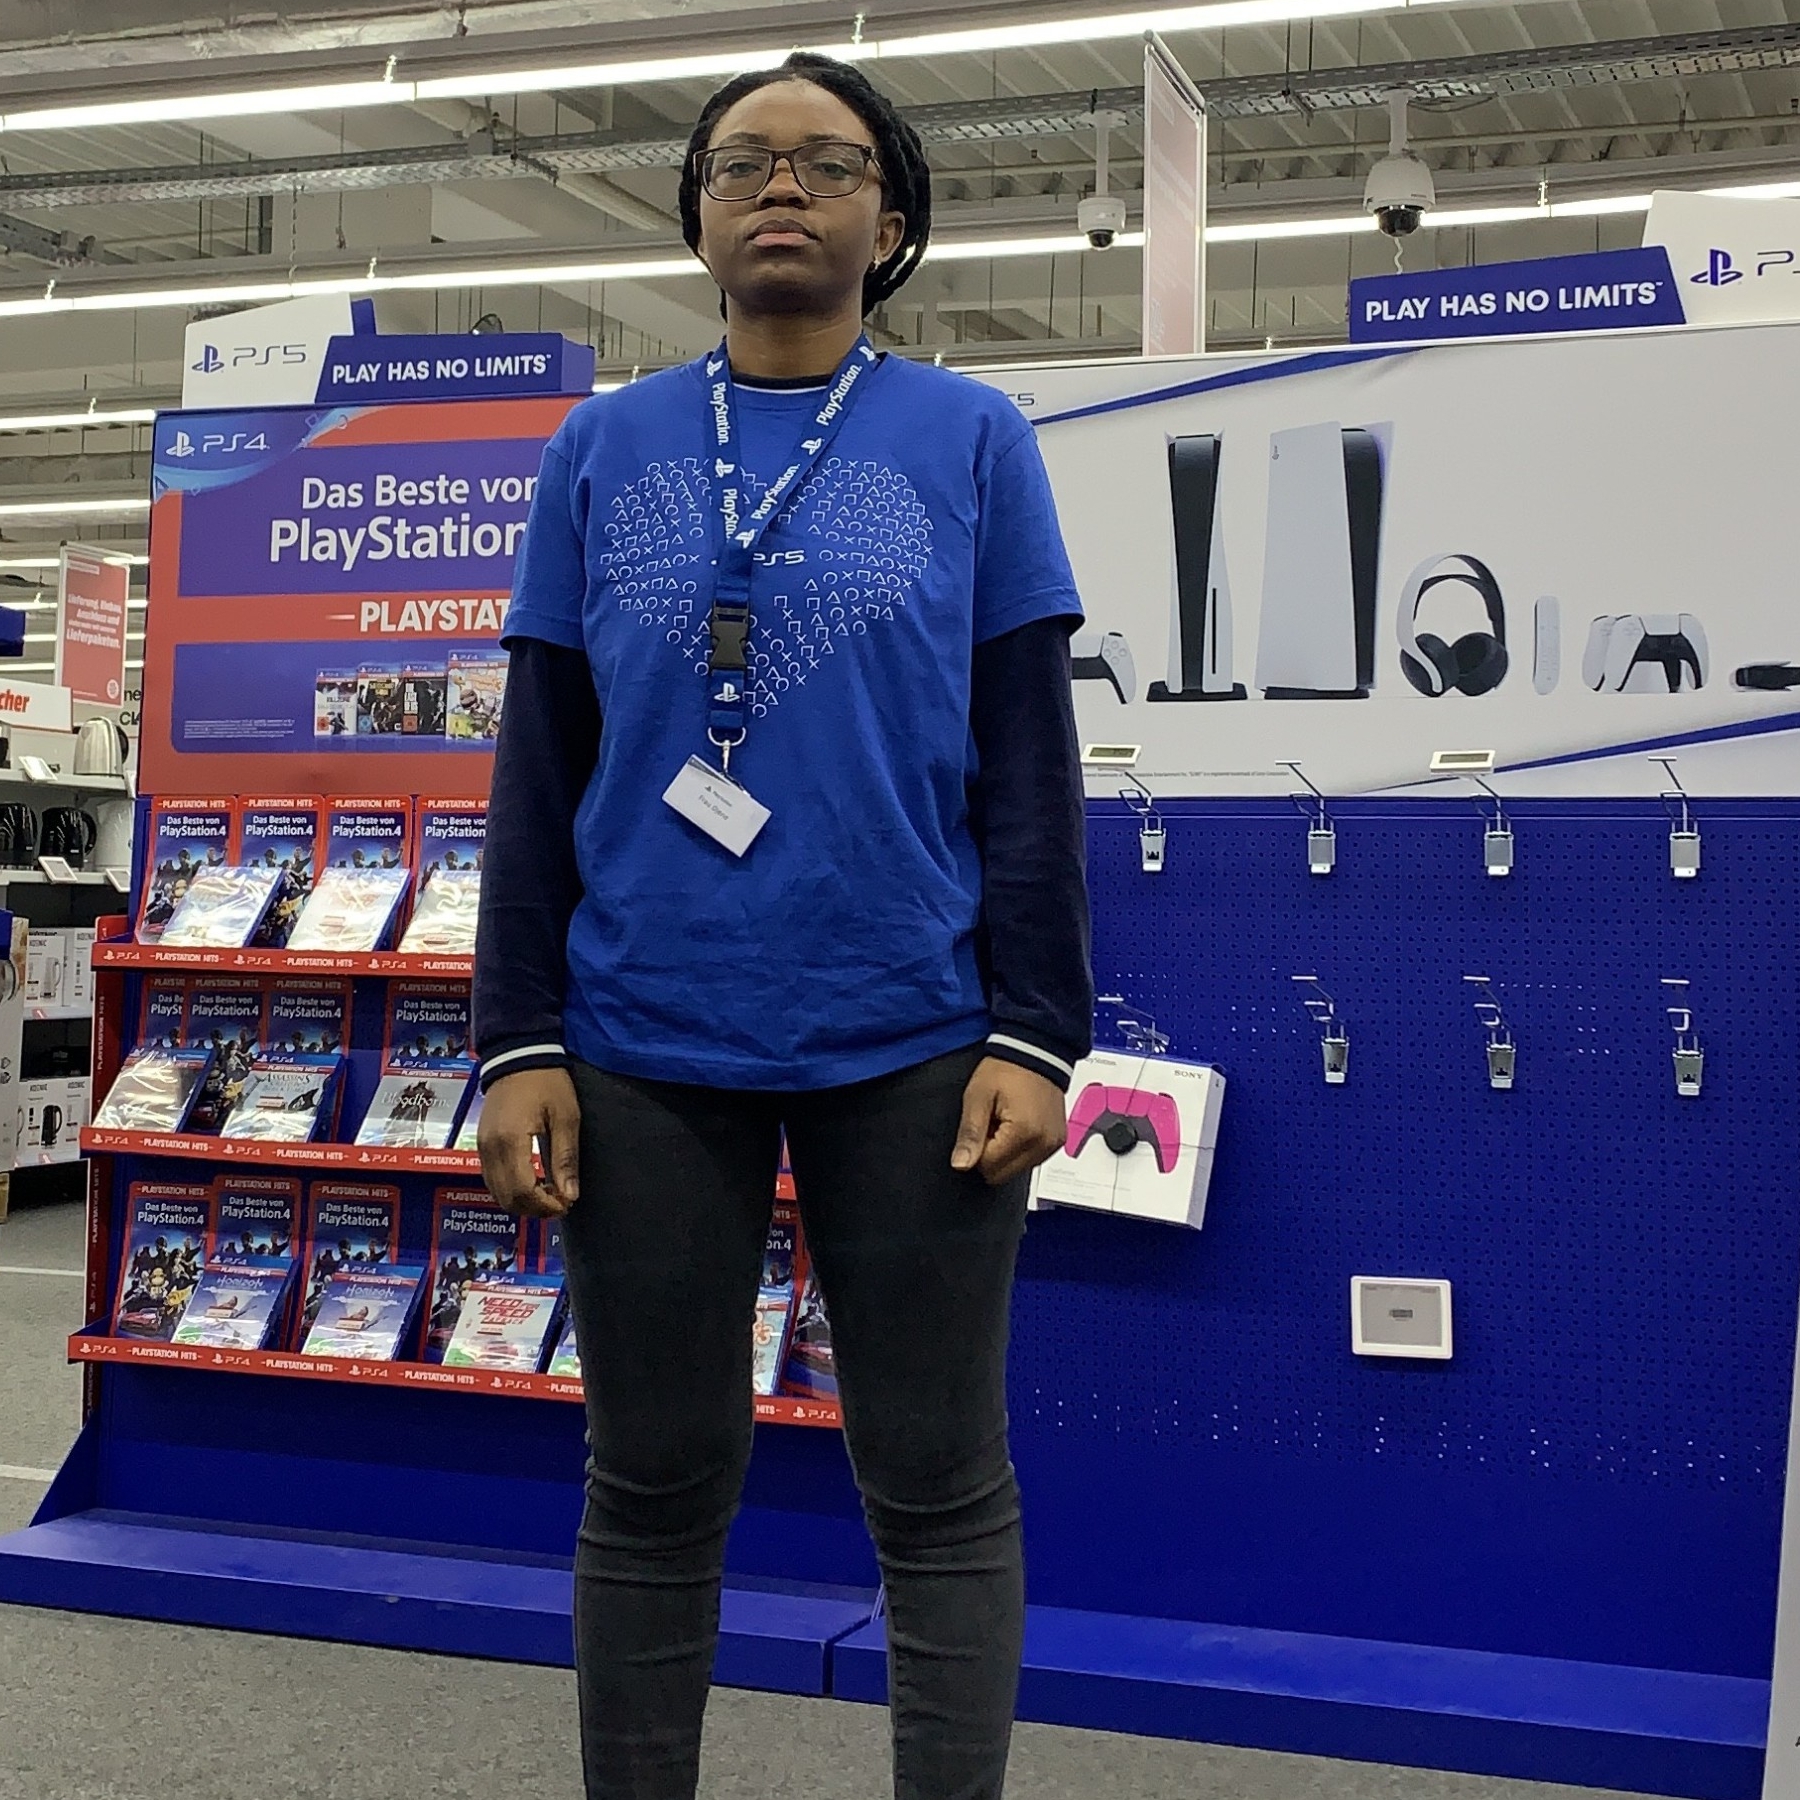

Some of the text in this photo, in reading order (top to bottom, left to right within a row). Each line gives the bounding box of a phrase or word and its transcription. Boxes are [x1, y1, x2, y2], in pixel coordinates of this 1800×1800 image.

[1757, 250, 1800, 276] P
[1366, 297, 1430, 323] PLAY
[1440, 293, 1496, 317] HAS
[1506, 289, 1549, 313] NO
[233, 344, 306, 367] PS5
[333, 365, 380, 383] PLAY
[388, 362, 429, 381] HAS
[436, 359, 468, 379] NO
[203, 433, 266, 452] PS4
[303, 478, 364, 508] Das
[375, 475, 470, 506] Beste
[753, 550, 805, 566] PS5
[162, 800, 226, 808] PLAYSTATION HITS
[249, 799, 312, 807] PLAYSTATION HITS
[335, 800, 400, 808] PLAYSTATION HITS
[427, 800, 475, 808] PLAYSTATION
[167, 816, 220, 825] Das Beste von
[253, 816, 307, 824] Das Beste von
[340, 816, 395, 825] Das Beste von
[433, 817, 447, 825] Das
[449, 817, 471, 825] Beste
[116, 952, 472, 970] PS4 PLAYSTATION HITS PS4 PLAYSTATION HITS PS4 PLAYSTATION
[159, 994, 173, 1003] Das
[200, 995, 214, 1004] Das
[238, 996, 252, 1004] von
[281, 996, 295, 1005] Das
[320, 998, 335, 1006] von
[404, 1000, 418, 1009] Das
[421, 1001, 442, 1009] Beste
[1174, 1069, 1204, 1079] SONY
[104, 1137, 129, 1145] PS4
[144, 1138, 189, 1149] PLAYSTATION
[192, 1143, 208, 1151] HITS
[236, 1146, 260, 1156] PS4
[277, 1149, 324, 1160] PLAYSTATION
[326, 1151, 343, 1160] HITS
[372, 1154, 397, 1162] PS4
[414, 1155, 463, 1166] PLAYSTATION
[230, 1197, 284, 1207] Das Beste von
[145, 1203, 159, 1211] Das
[160, 1203, 182, 1212] Beste
[326, 1203, 382, 1214] Das Beste von
[451, 1210, 509, 1221] Das Beste von
[478, 1296, 523, 1308] NEED
[478, 1306, 534, 1318] SPEED
[92, 1345, 117, 1354] PS4
[132, 1346, 178, 1359] PLAYSTATION
[181, 1350, 197, 1360] HITS
[225, 1355, 250, 1365] PS4
[266, 1359, 314, 1371] PLAYSTATION
[316, 1362, 333, 1372] HITS
[363, 1367, 387, 1377] PS4
[405, 1370, 454, 1383] PLAYSTATION
[457, 1375, 474, 1385] HITS
[505, 1380, 531, 1390] PS4
[756, 1404, 775, 1415] HITS
[809, 1409, 837, 1420] PS4
